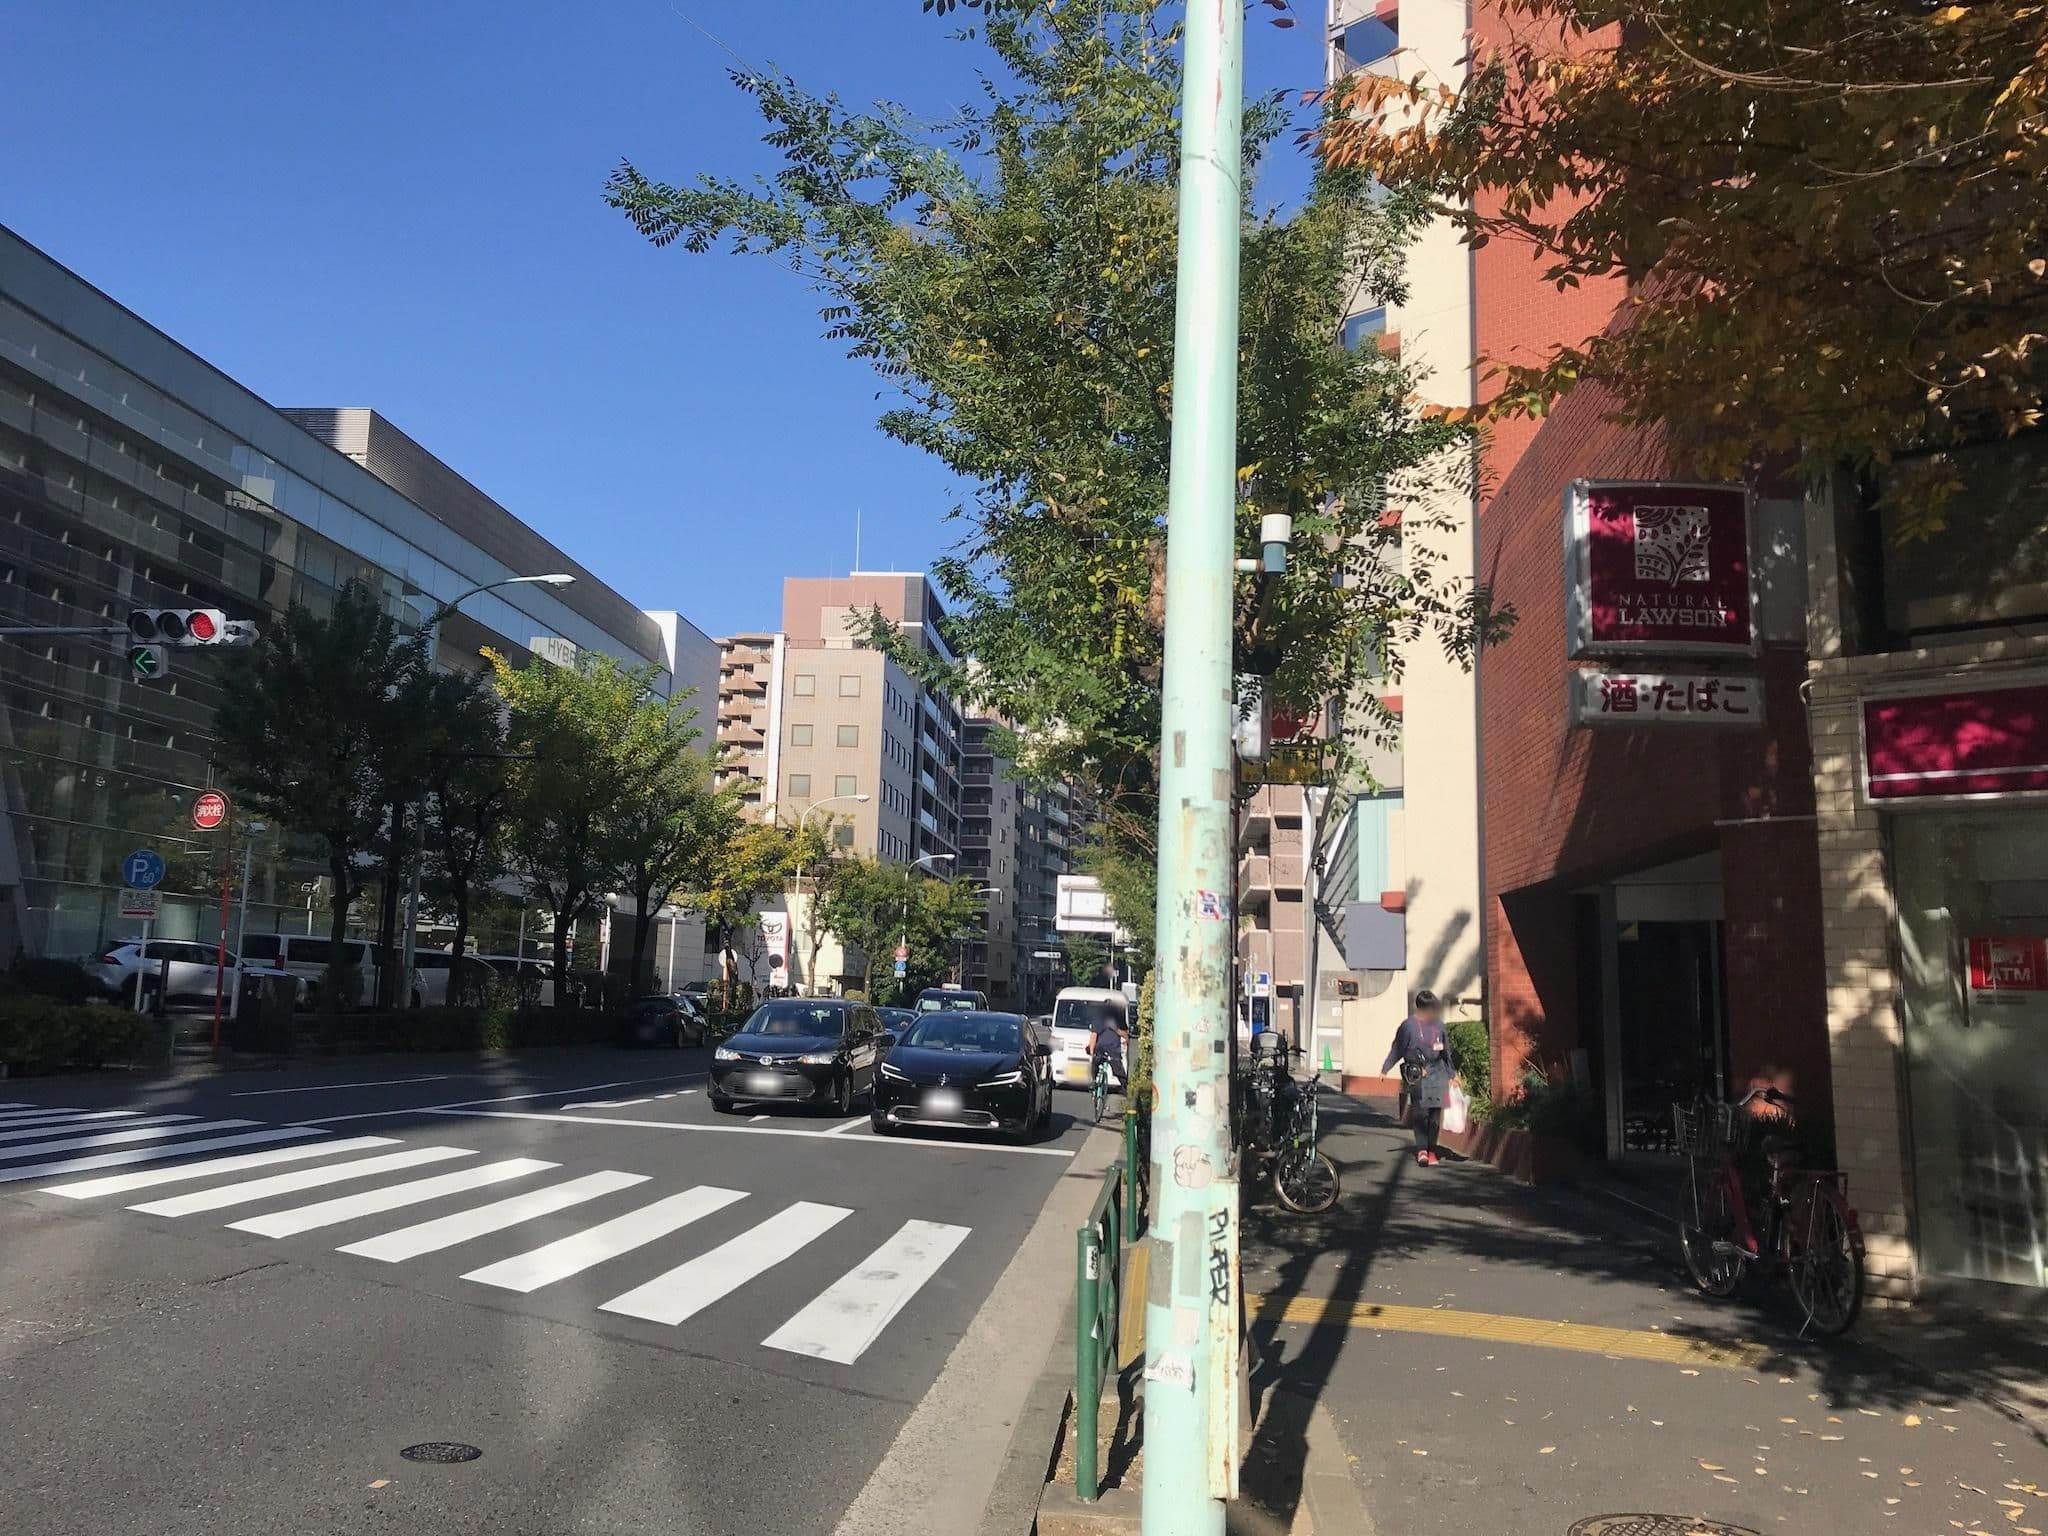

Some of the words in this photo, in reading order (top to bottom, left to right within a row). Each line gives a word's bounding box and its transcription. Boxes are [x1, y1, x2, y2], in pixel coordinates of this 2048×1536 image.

[1619, 594, 1727, 608] NATURAL
[1619, 608, 1727, 627] LAWSON
[197, 804, 222, 817] 消火栓
[131, 858, 149, 883] P
[1987, 967, 2031, 983] ATM
